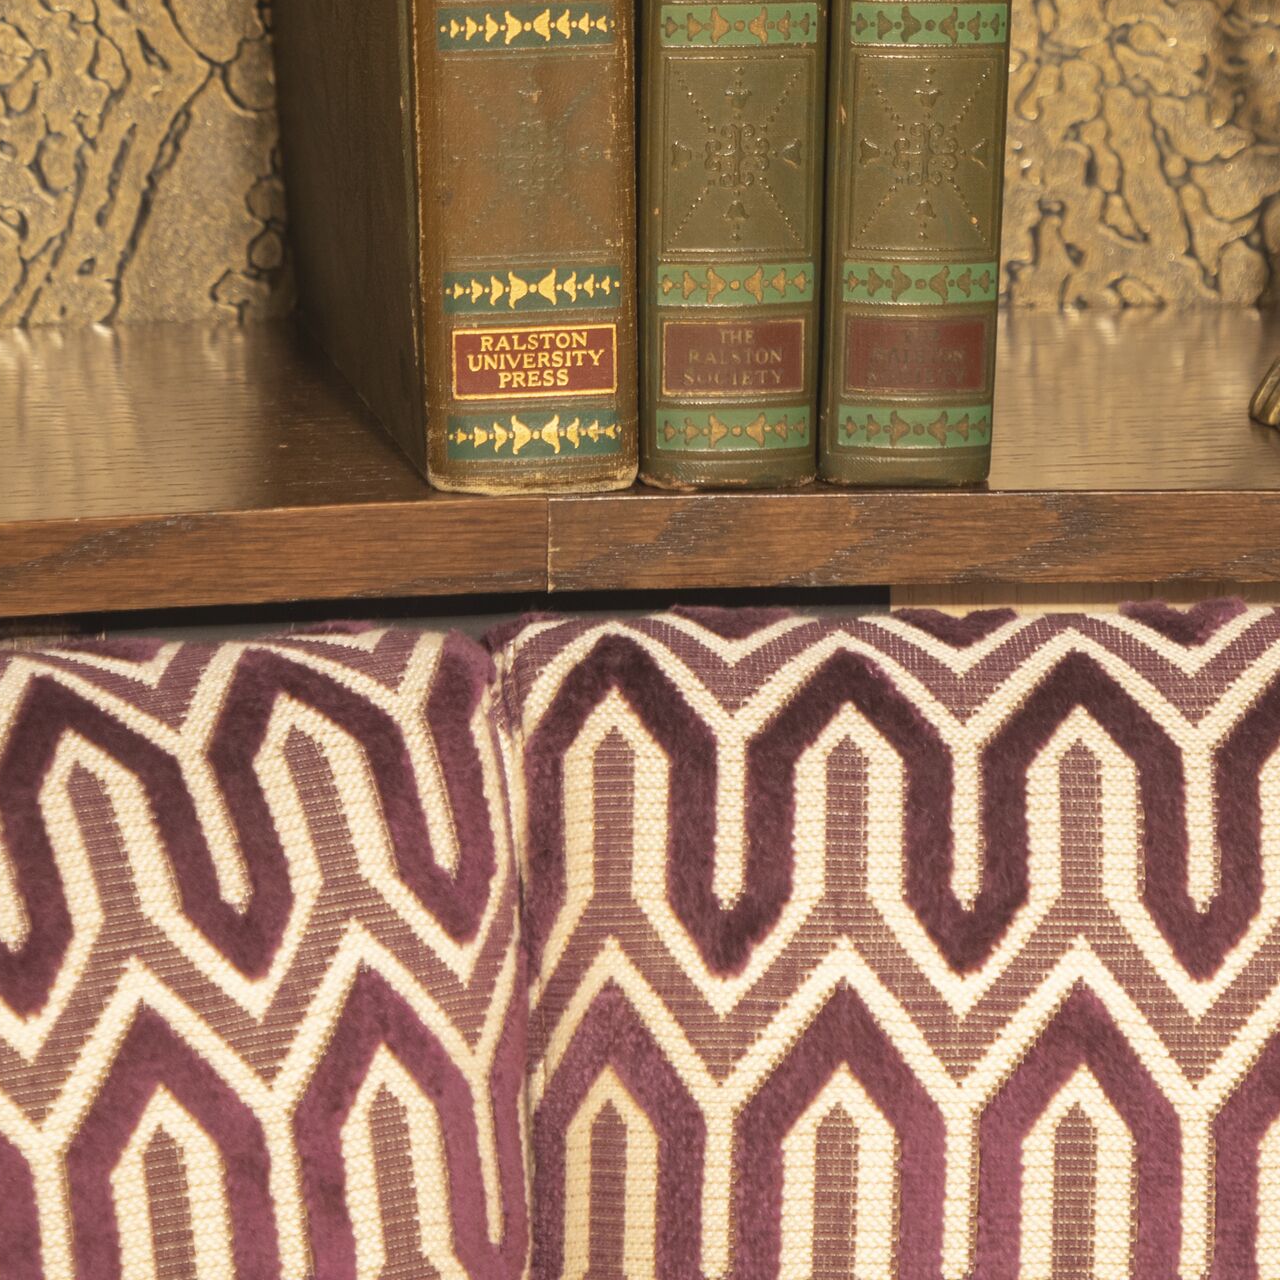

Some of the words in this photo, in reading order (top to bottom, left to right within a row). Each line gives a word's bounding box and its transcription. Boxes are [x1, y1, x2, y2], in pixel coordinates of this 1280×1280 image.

[480, 332, 588, 352] RALSTON
[719, 328, 755, 345] THE
[467, 349, 605, 371] UNIVERSITY
[688, 347, 783, 365] RALSTON
[498, 369, 569, 389] PRESS
[683, 368, 784, 386] SOCIETY
